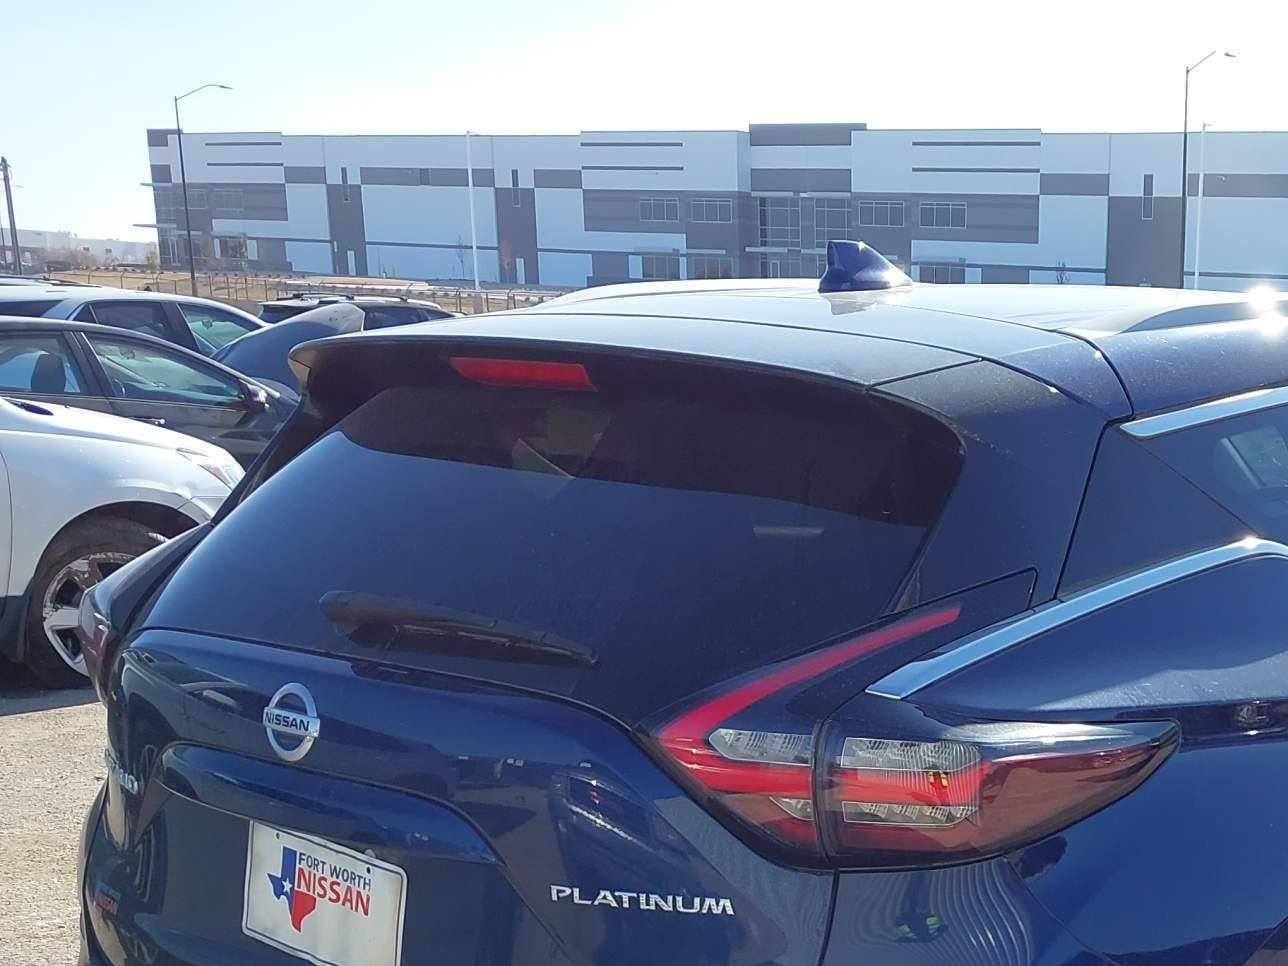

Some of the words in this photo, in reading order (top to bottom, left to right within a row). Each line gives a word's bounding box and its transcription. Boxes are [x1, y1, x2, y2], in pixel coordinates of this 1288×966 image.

[264, 710, 310, 732] NISSAN
[298, 852, 327, 875] FORT
[329, 863, 371, 892] WORTH
[296, 866, 371, 917] NISSAN
[550, 884, 735, 916] PLATINUM
